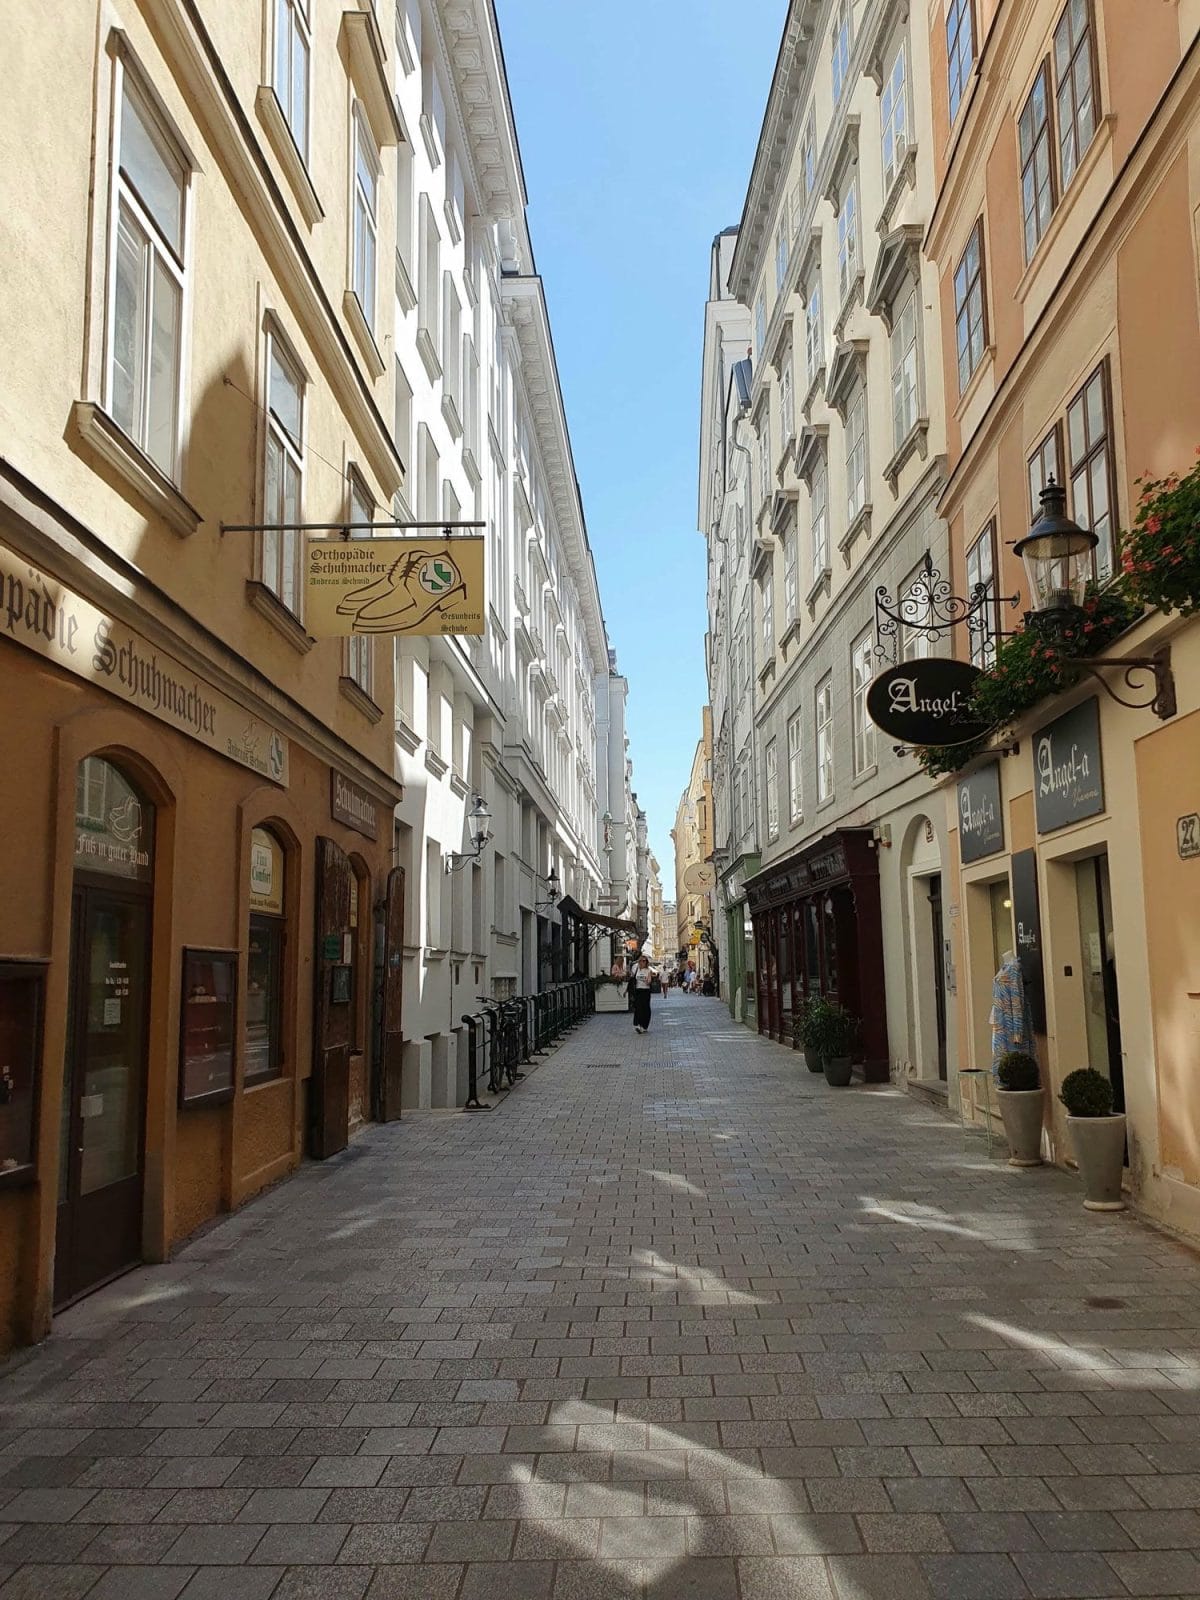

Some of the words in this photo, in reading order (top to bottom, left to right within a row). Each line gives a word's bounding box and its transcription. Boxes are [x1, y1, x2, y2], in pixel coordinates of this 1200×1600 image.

[309, 562, 387, 575] Schuhmacher
[310, 548, 375, 562] Orthopädie
[92, 618, 216, 737] Schuhmacher
[1037, 733, 1090, 799] Angel-a
[1181, 818, 1196, 845] 27
